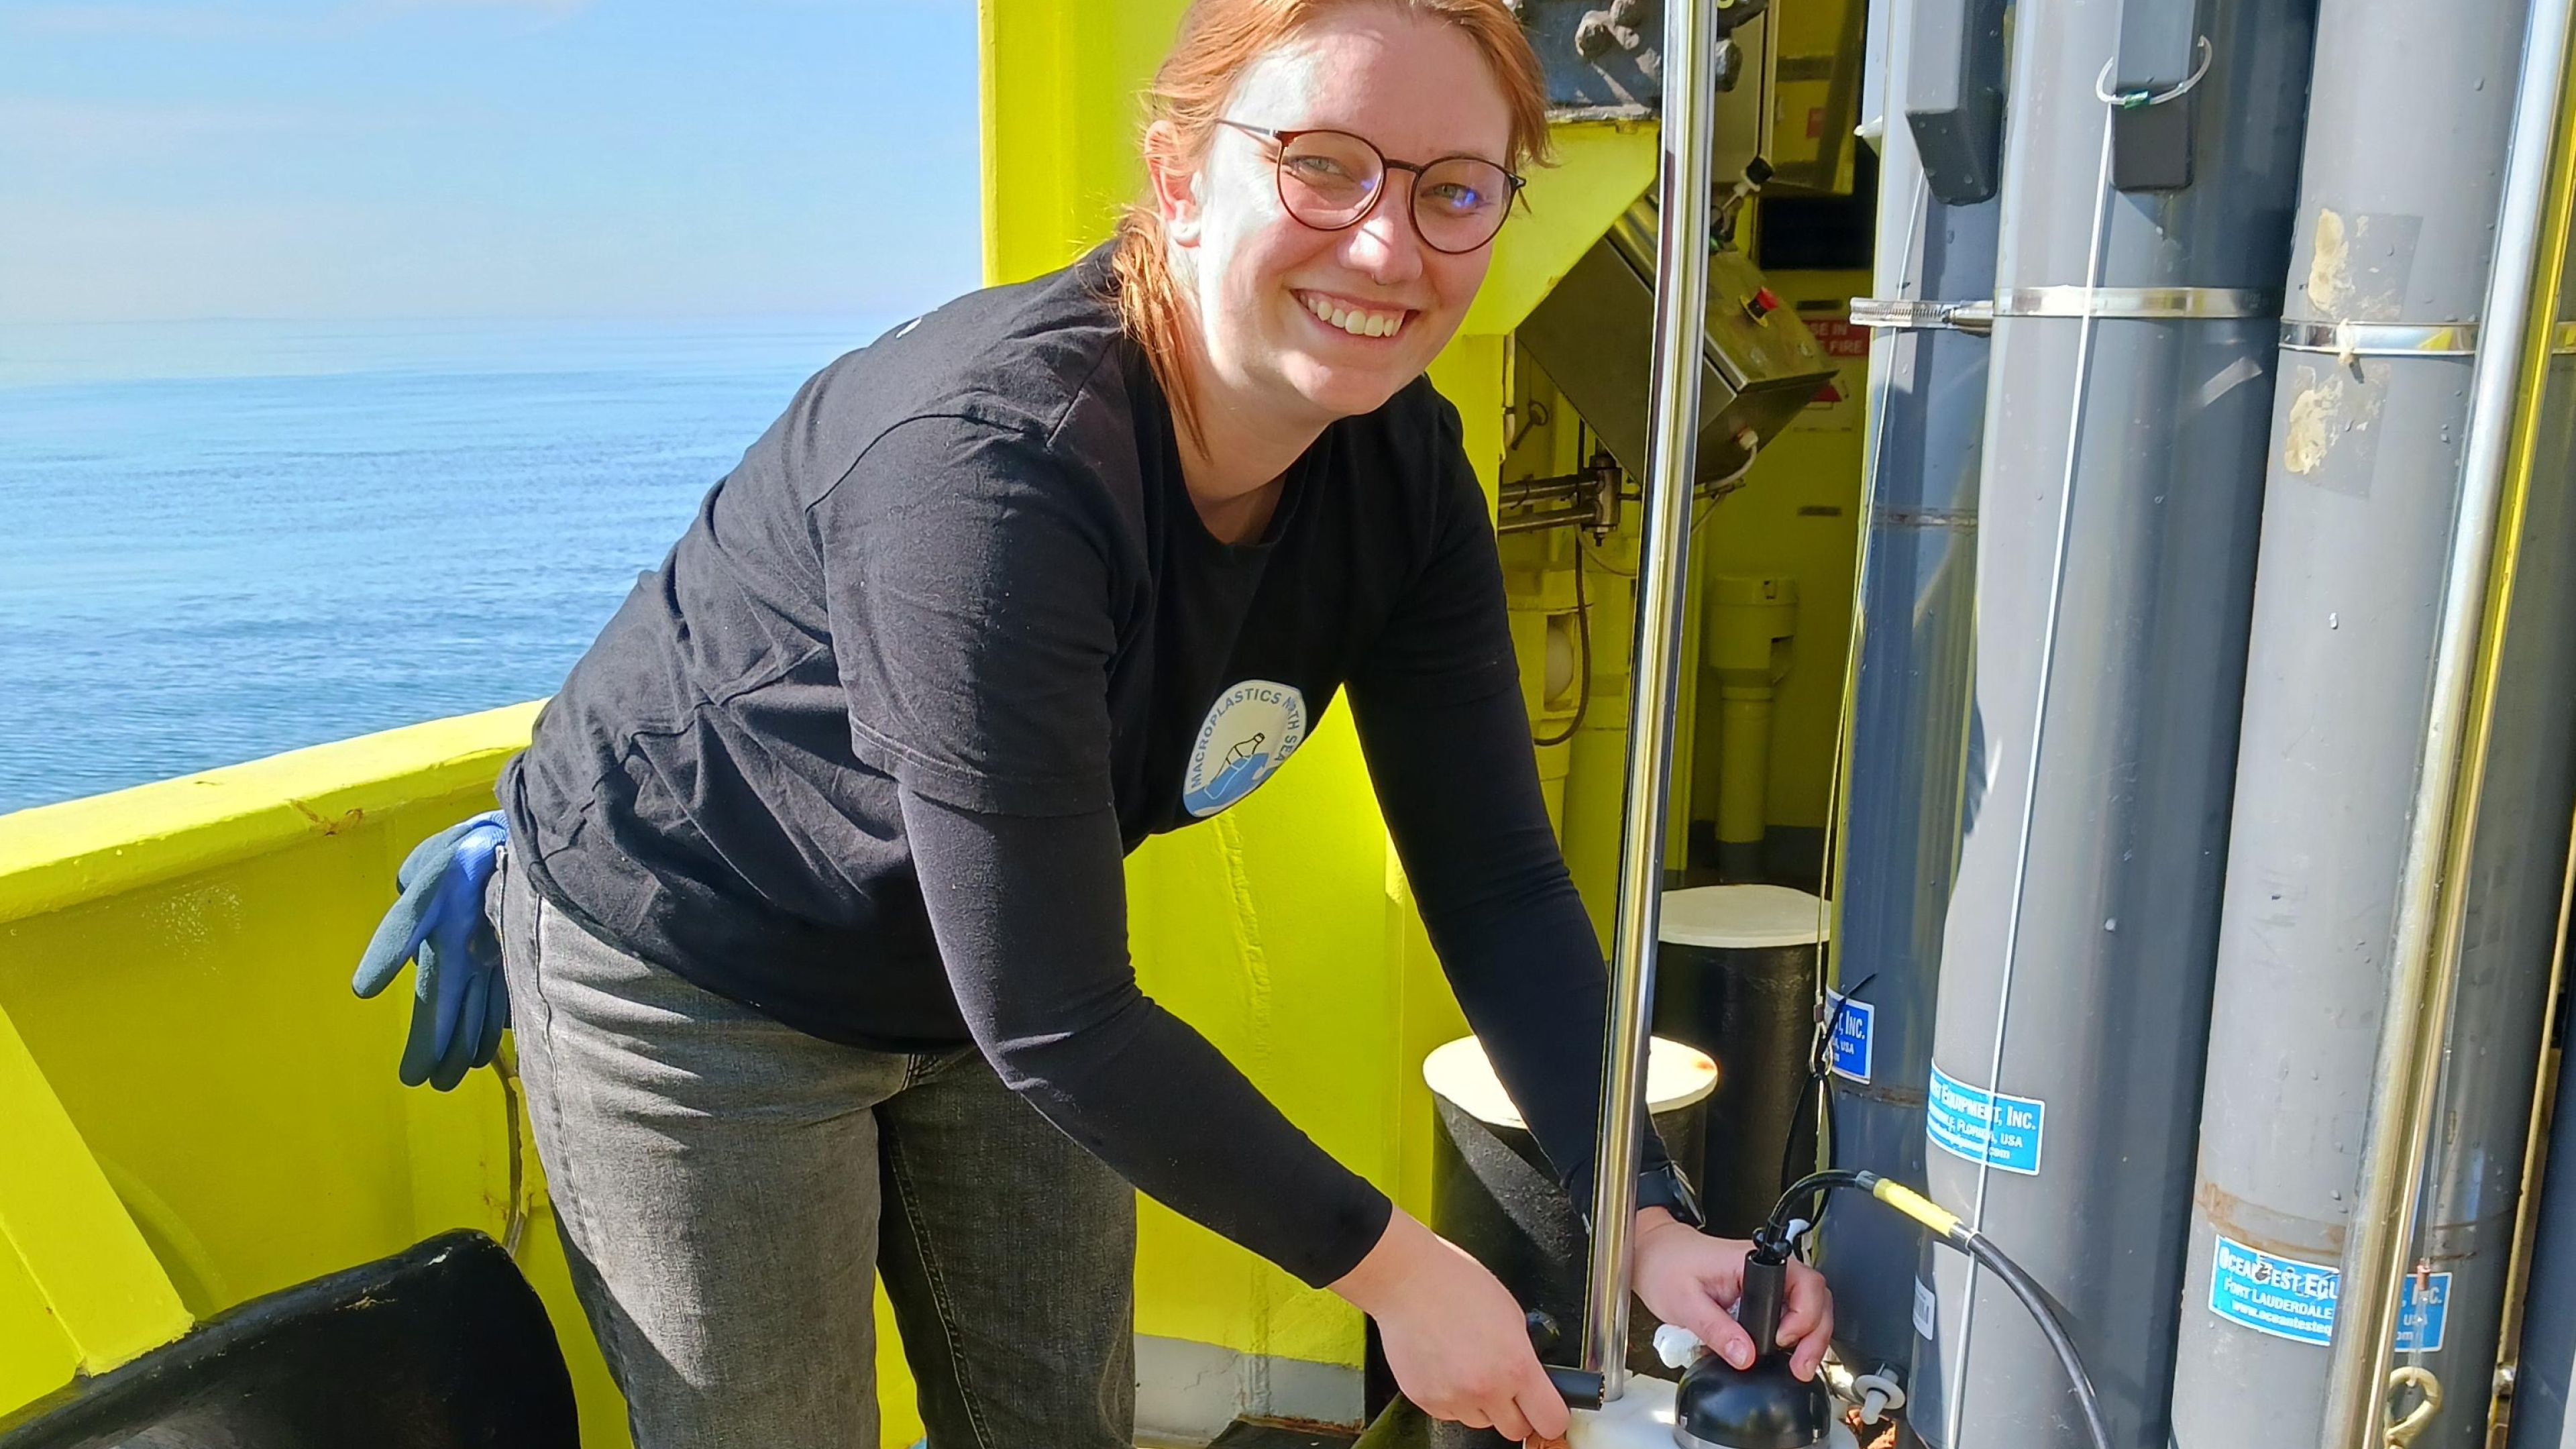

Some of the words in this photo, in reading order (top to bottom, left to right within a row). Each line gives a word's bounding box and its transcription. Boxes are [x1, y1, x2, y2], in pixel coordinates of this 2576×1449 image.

[1832, 323, 1847, 335] IN
[1829, 339, 1864, 354] FIRE
[1191, 688, 1281, 788] MACROPLASTICS
[1275, 735, 1297, 761] SEA
[1845, 1010, 1865, 1040] INC.
[1841, 1042, 1854, 1055] USA
[1942, 1083, 2002, 1126] EQUIPMET,
[2006, 1106, 2036, 1130] INC.
[1957, 1118, 1997, 1144] FLORIA,
[2000, 1133, 2023, 1148] USA
[2224, 1276, 2252, 1299] FORT
[2252, 1288, 2332, 1320] LAUDERDALE
[2412, 1284, 2442, 1305] IC.
